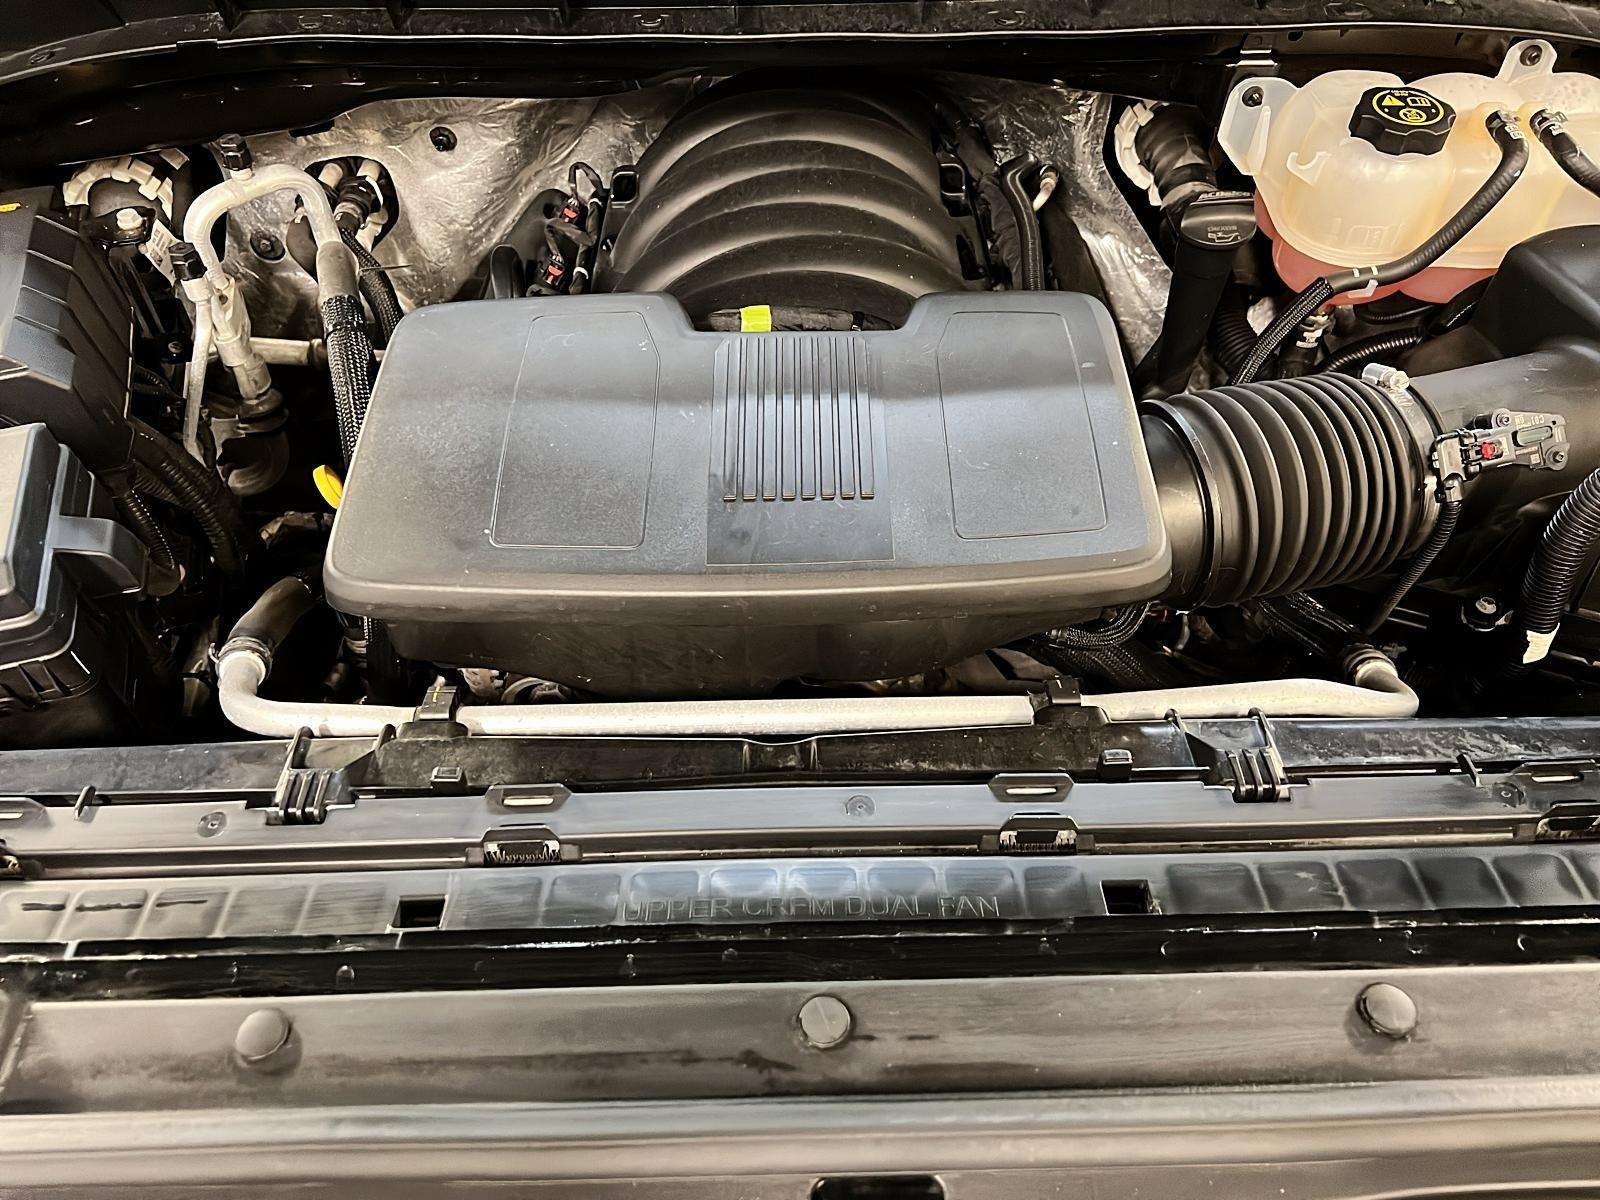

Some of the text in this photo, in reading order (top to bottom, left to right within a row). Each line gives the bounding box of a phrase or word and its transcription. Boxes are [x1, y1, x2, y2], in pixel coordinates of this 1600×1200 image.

[623, 897, 733, 921] UPPER
[845, 895, 931, 917] DUAL
[938, 896, 1000, 918] FAN
